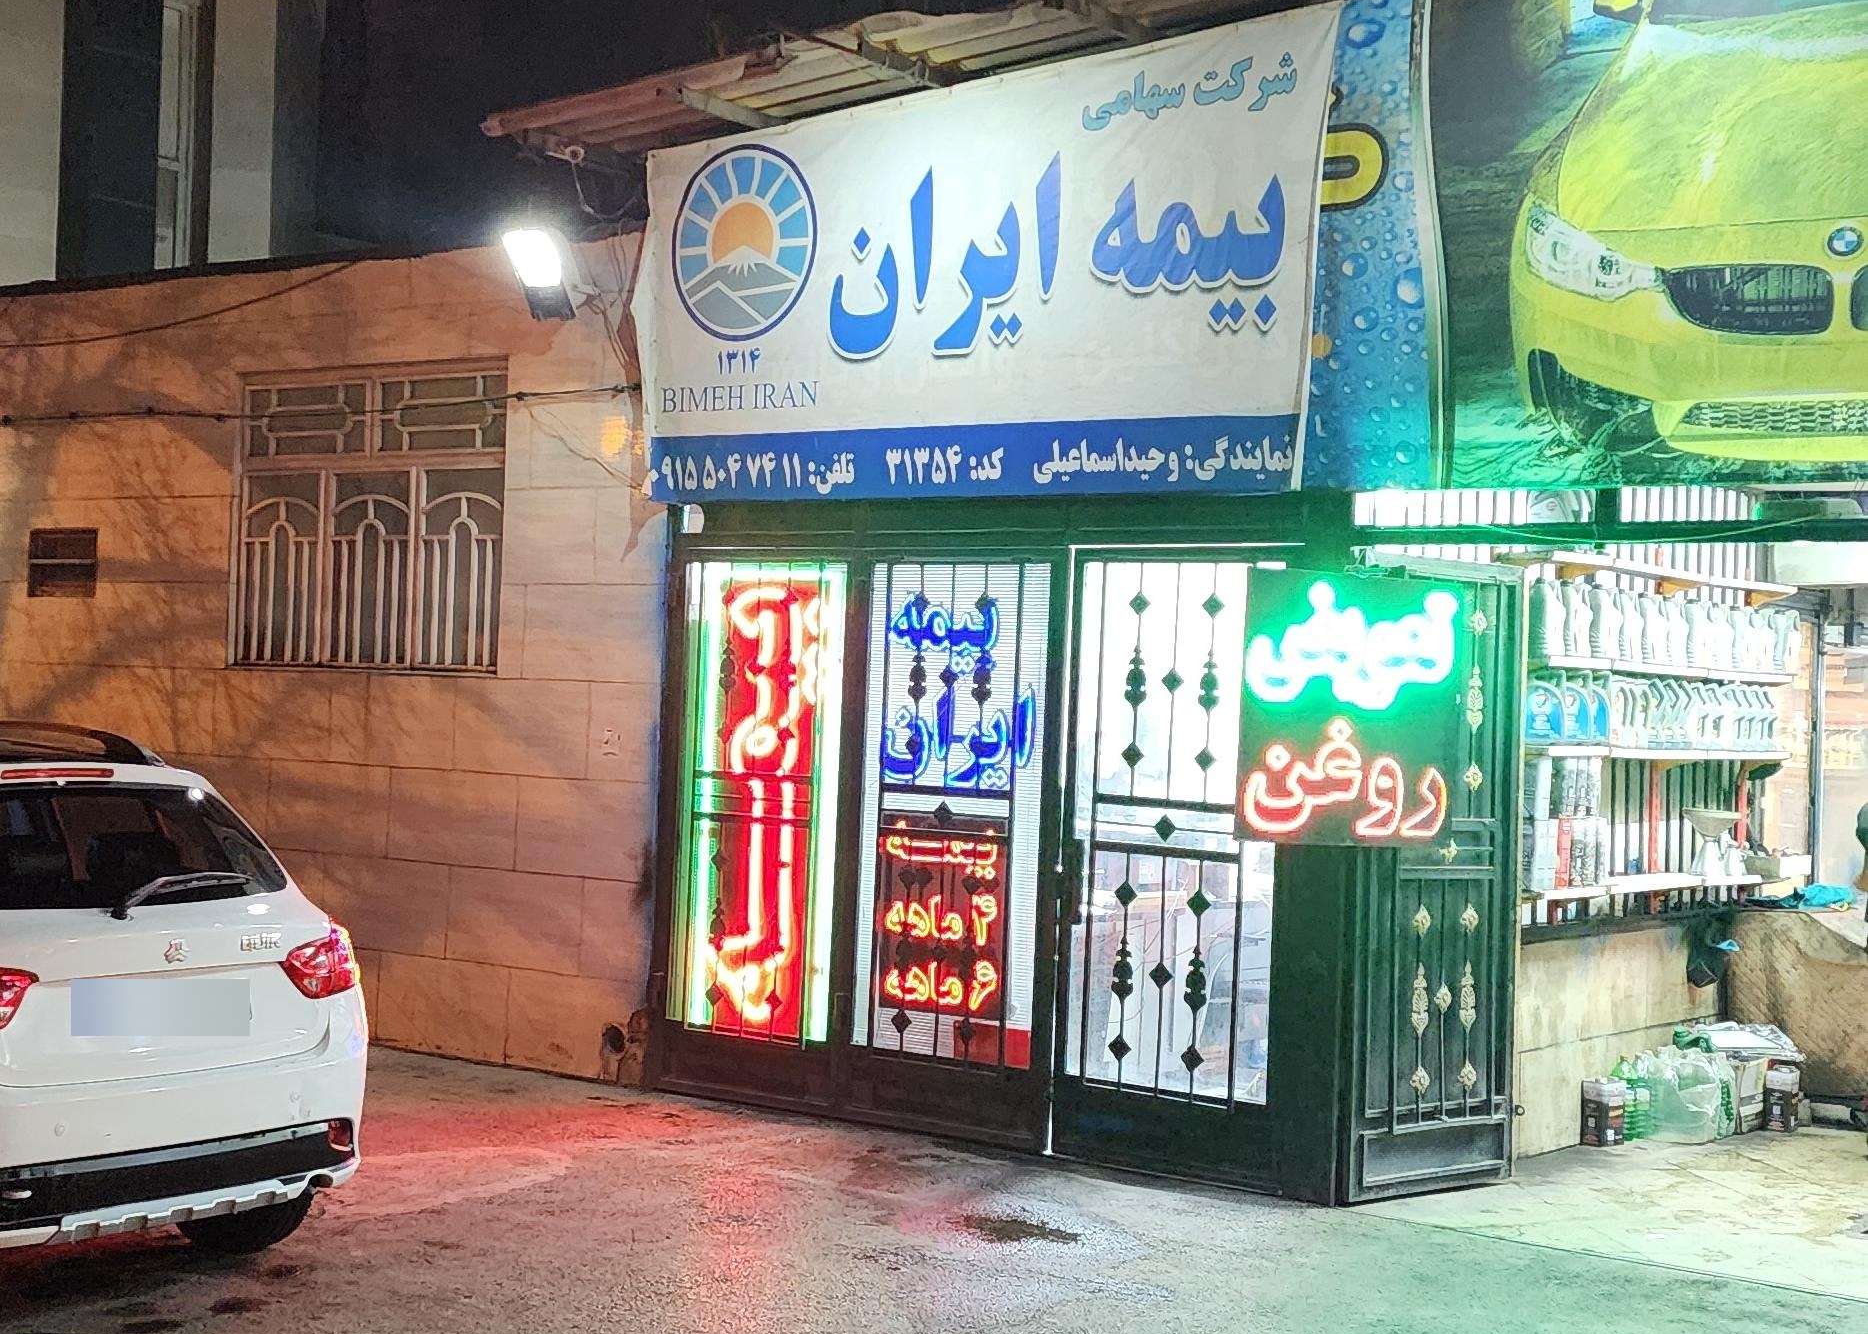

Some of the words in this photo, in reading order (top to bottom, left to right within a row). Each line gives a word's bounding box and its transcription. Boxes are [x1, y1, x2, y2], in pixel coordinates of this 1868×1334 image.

[1082, 70, 1186, 132] سهامی
[1193, 52, 1298, 112] شرکت
[827, 150, 1063, 360] ایران
[1090, 172, 1287, 332] بیمه
[717, 347, 762, 376] ۱۳۱۴
[661, 384, 745, 414] BIMEH
[752, 379, 819, 411] IRAN
[808, 451, 856, 496] تلفن:
[886, 444, 962, 486] ۳۱۳۵۴
[969, 447, 1004, 482] کد:
[1185, 435, 1293, 482] نمایندگی:
[889, 592, 999, 674] بیمه
[883, 684, 1036, 788] ایران
[1244, 716, 1446, 837] روغن
